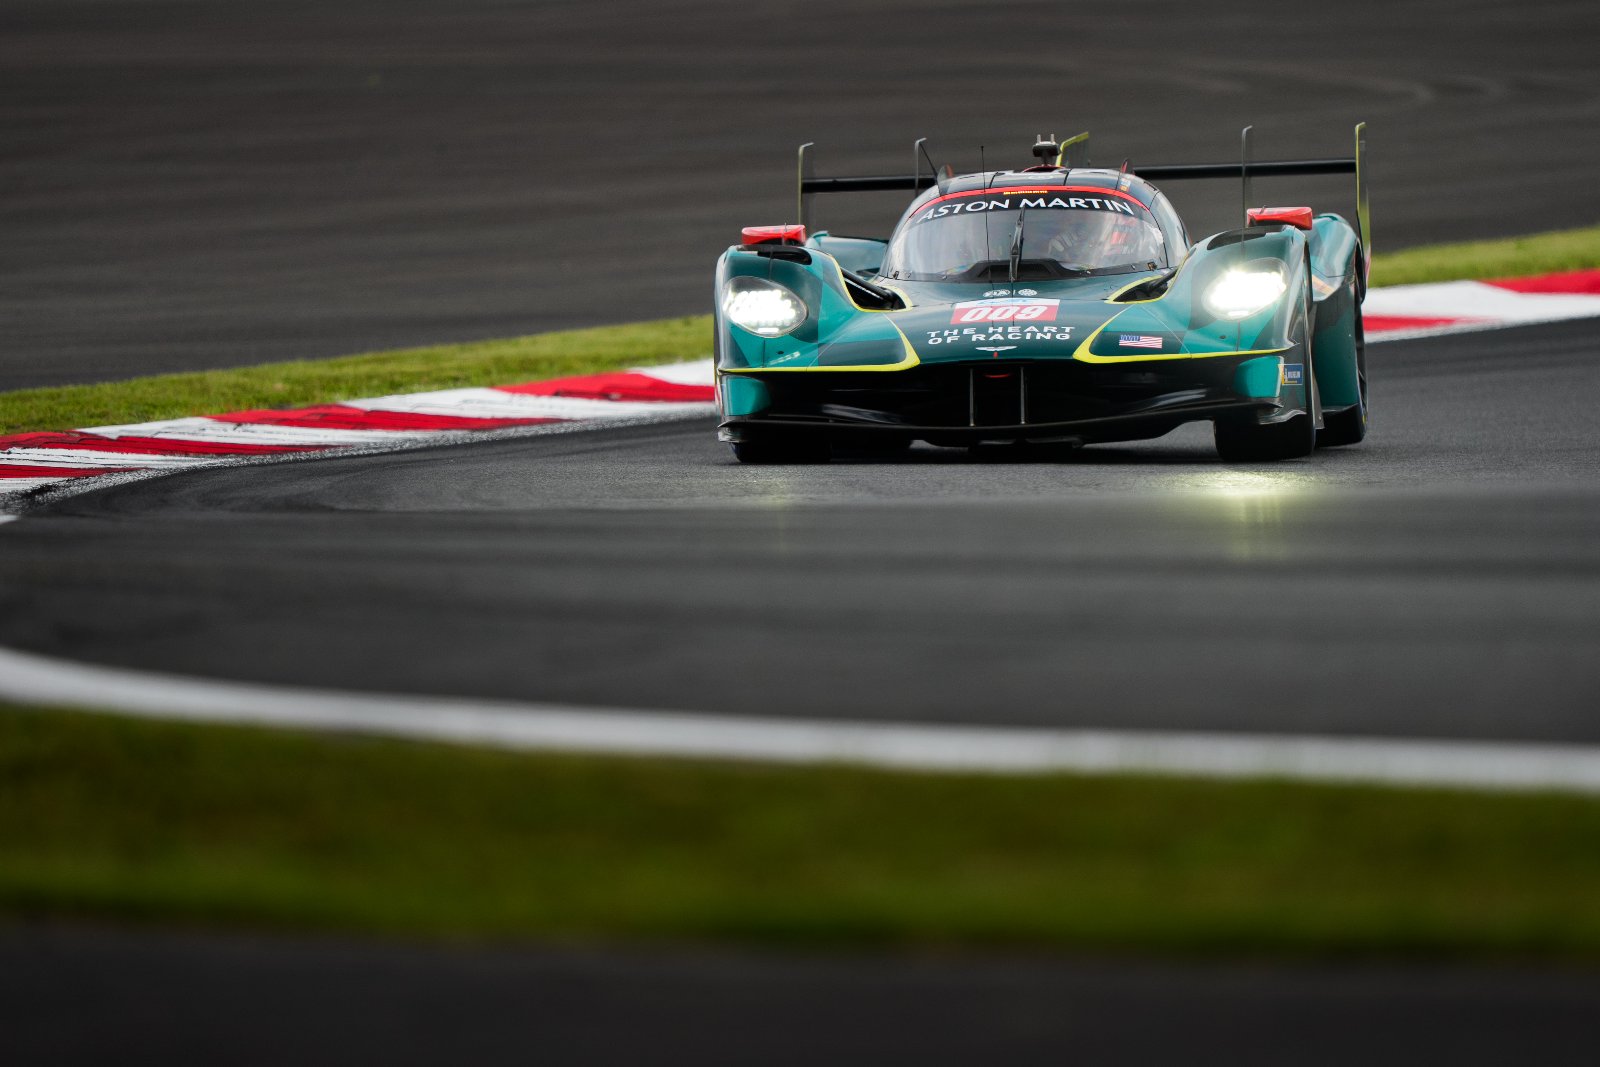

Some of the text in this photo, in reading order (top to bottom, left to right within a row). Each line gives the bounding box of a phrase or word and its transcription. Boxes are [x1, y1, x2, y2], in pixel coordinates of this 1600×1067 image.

[917, 197, 1134, 223] ASTON MARTIN
[960, 305, 1047, 321] 009
[926, 325, 1076, 338] THE HEART
[928, 332, 1071, 345] OF RACING
